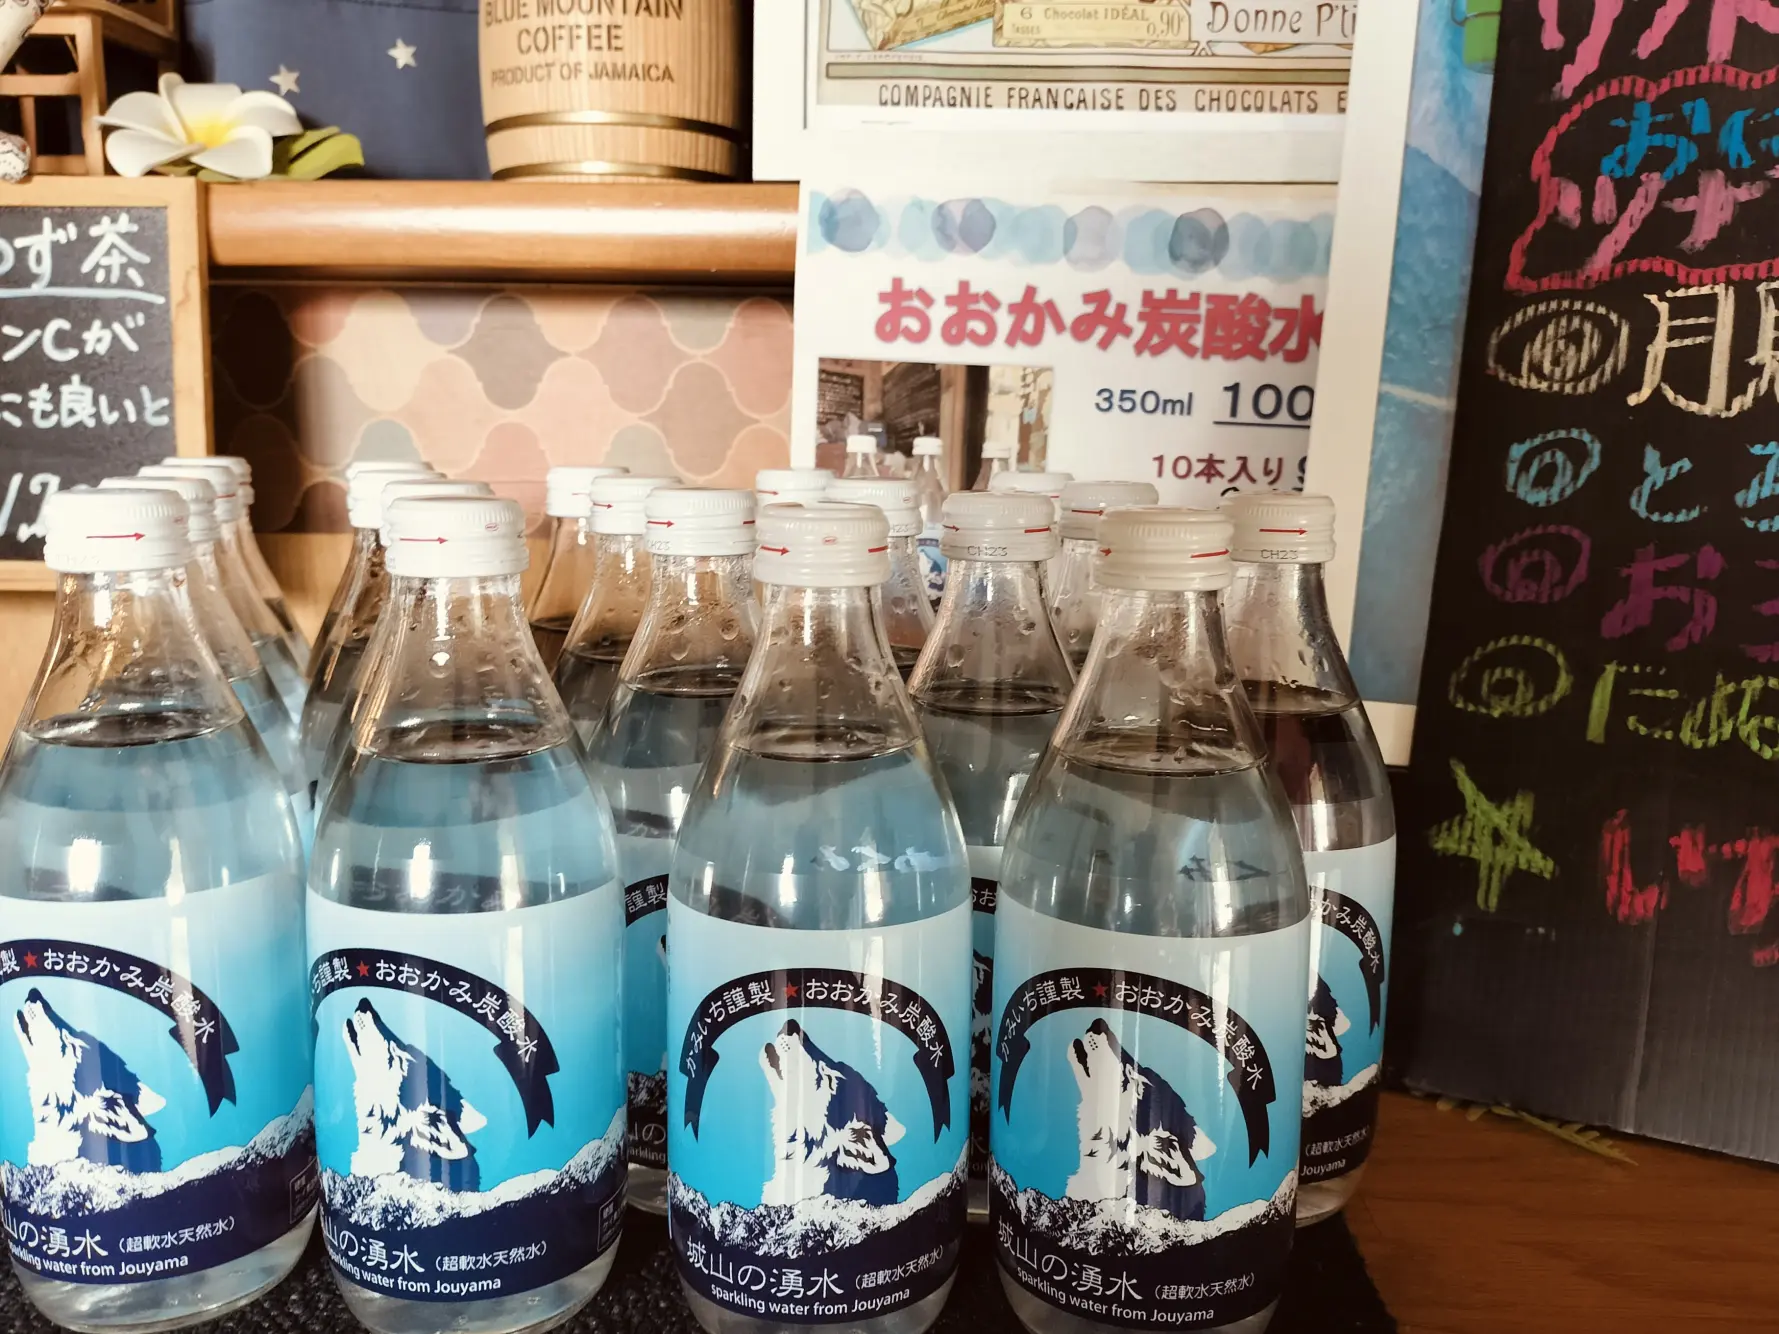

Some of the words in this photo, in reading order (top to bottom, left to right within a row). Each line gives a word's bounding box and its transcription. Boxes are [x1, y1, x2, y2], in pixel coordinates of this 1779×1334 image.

[1044, 7, 1099, 21] Chocolat
[1207, 1, 1302, 34] Donne
[517, 24, 624, 54] COFFEE
[491, 61, 555, 87] PRODUCT
[559, 62, 583, 81] OF
[588, 62, 675, 83] JAMAICA
[879, 84, 993, 108] COMPAGNIE
[1139, 88, 1177, 111] DES
[1195, 89, 1318, 113] CHOCOLATS
[875, 277, 1324, 363] おおかみ炭酸水
[1095, 387, 1193, 416] 350ml
[1223, 382, 1314, 421] 100
[1152, 453, 1284, 485] 10本入り
[1311, 897, 1380, 974] かみ炭酸水
[43, 948, 215, 1044] おおかみ炭酸水
[375, 959, 538, 1063] おおかみ炭酸水
[806, 978, 945, 1068] おおかみ炭酸水
[1115, 980, 1264, 1090] おおかみ炭酸水
[1301, 1159, 1346, 1176] Jouyama
[42, 1259, 78, 1276] water
[81, 1260, 115, 1276] from
[119, 1255, 189, 1277] Jouyama
[361, 1269, 395, 1288] water
[397, 1277, 430, 1293] from
[434, 1277, 501, 1296] Jouyama
[1017, 1265, 1066, 1304] sparkling
[1069, 1296, 1108, 1315] water
[1111, 1303, 1147, 1321] from
[1150, 1308, 1214, 1325] Jouyama
[711, 1283, 765, 1314] sparkling
[769, 1301, 808, 1315] water
[813, 1301, 848, 1315] from
[851, 1288, 910, 1313] Jouyama
